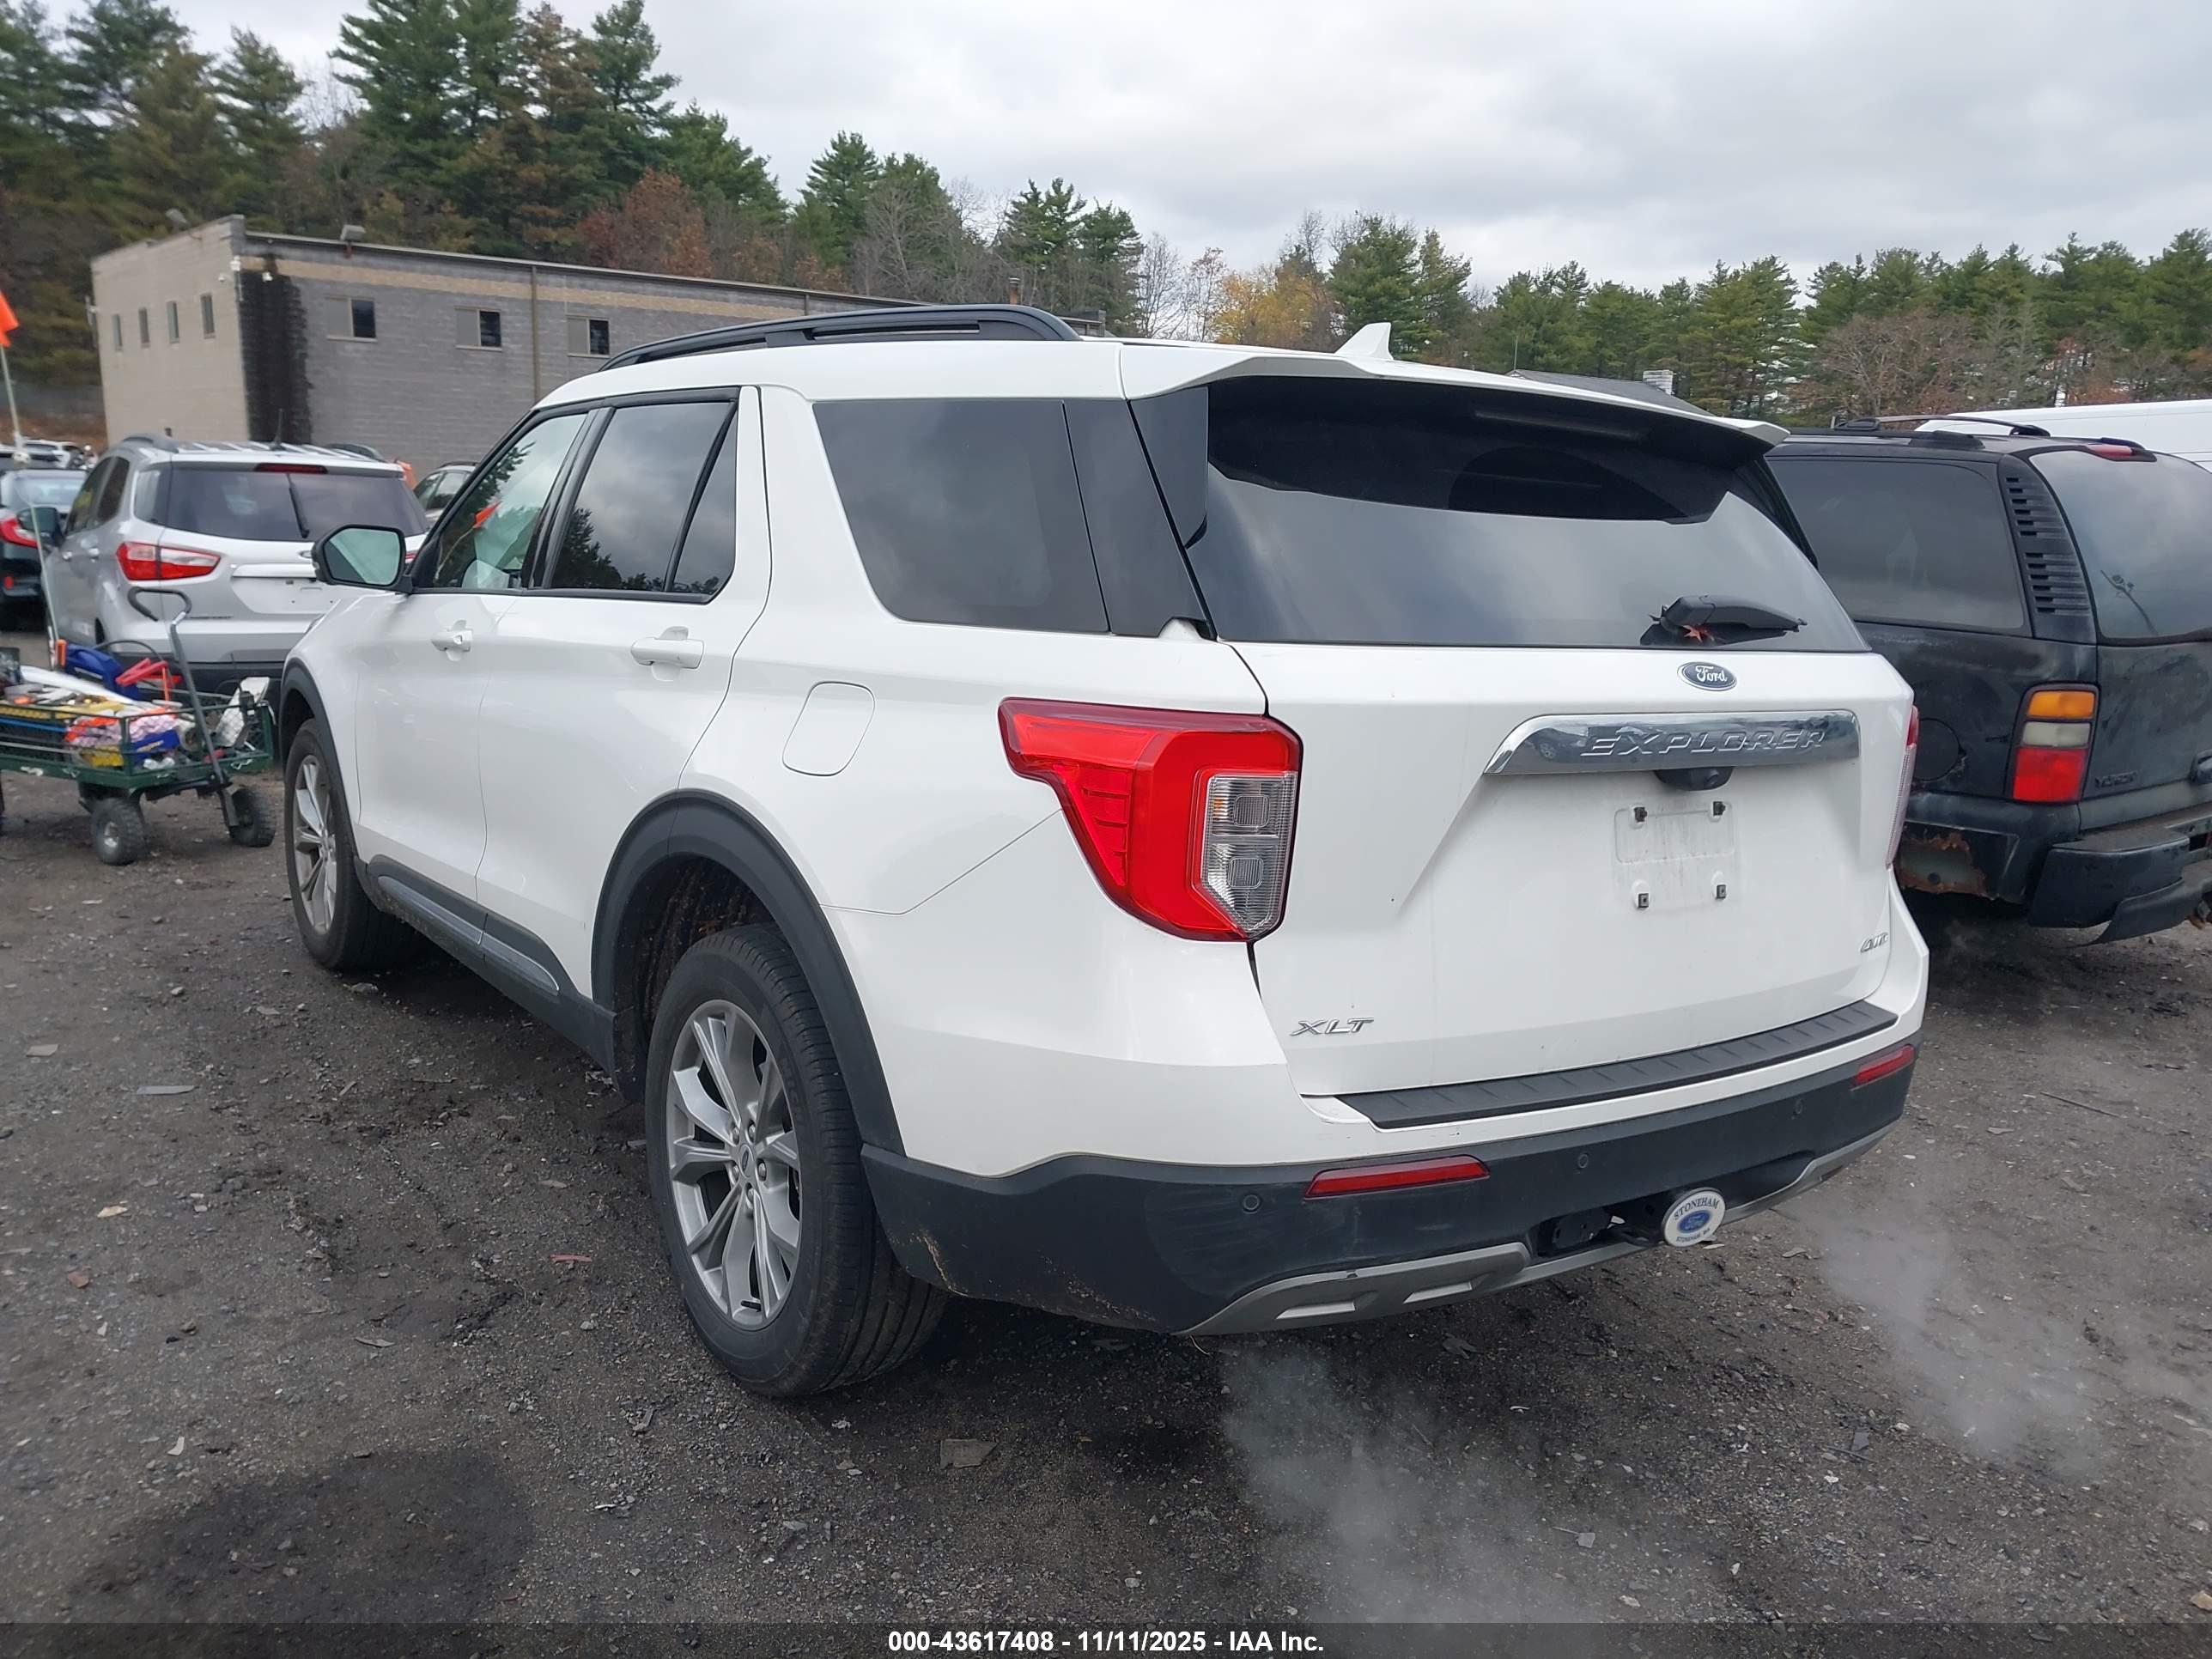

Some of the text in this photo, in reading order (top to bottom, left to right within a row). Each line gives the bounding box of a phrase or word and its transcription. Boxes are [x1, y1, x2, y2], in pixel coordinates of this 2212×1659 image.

[1695, 665, 1728, 682] Ford
[1580, 729, 1826, 756] EXPLORER
[1289, 1017, 1375, 1036] XLT
[1674, 1197, 1720, 1220] STONEHAM
